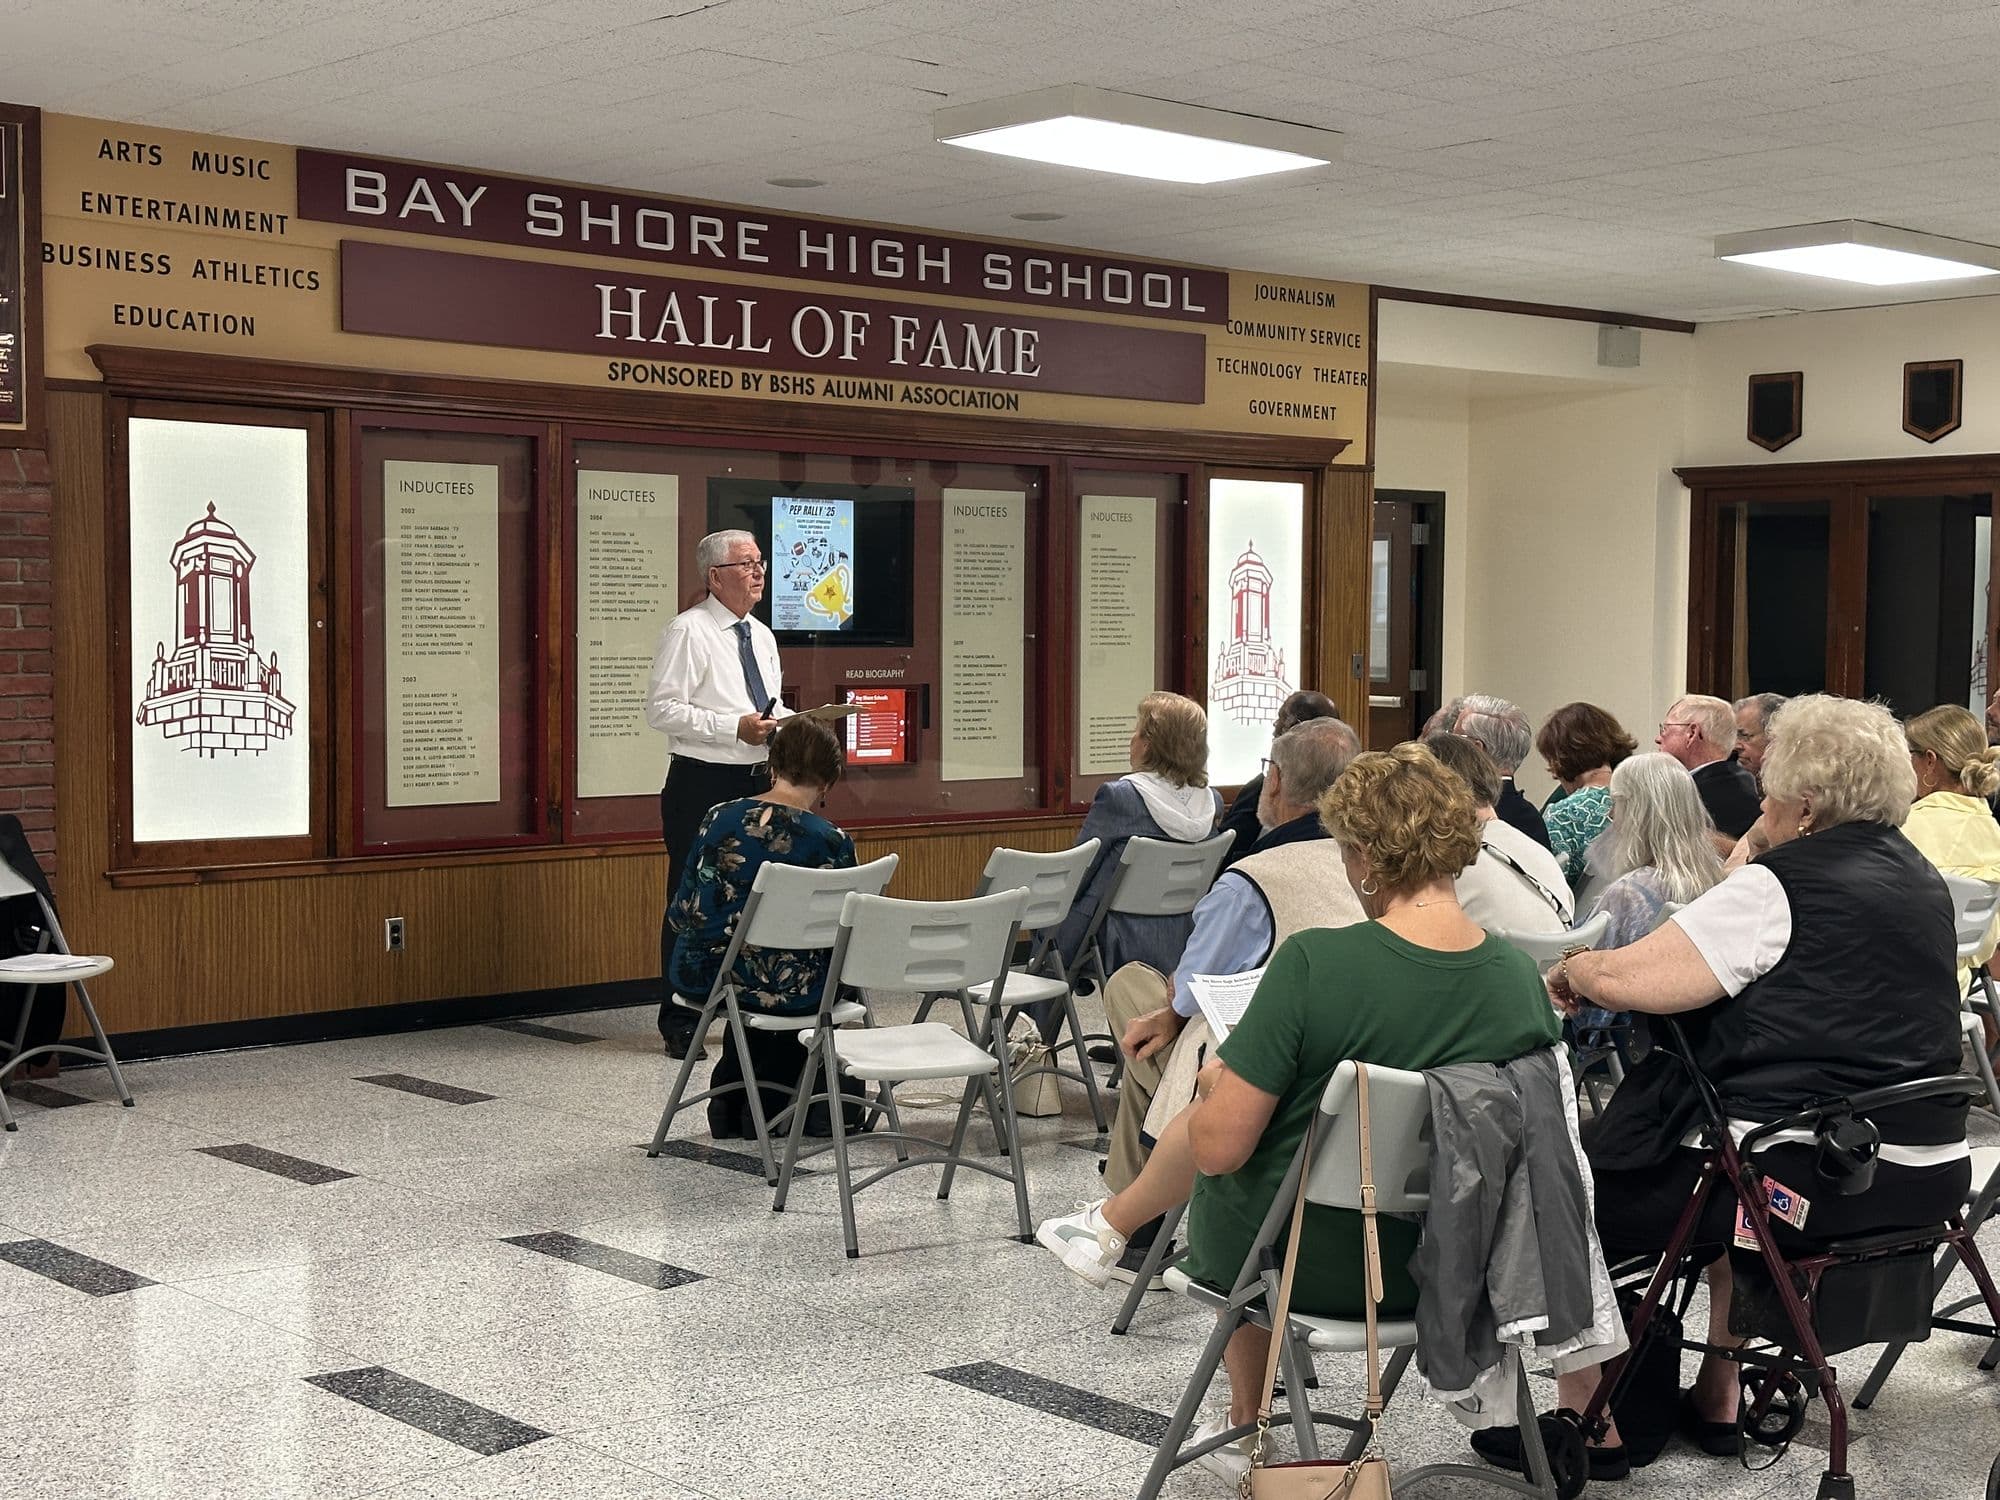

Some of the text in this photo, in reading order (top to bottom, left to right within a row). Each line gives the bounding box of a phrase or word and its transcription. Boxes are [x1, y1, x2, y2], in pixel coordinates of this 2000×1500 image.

[98, 138, 271, 180] ARTS MUSIC
[81, 191, 288, 235] ENTERTAINMENT
[345, 168, 1206, 313] BAY SHORE HIGH SCHOOL
[42, 242, 320, 290] BUSINESS ATHLETICS
[1254, 284, 1336, 308] JOURNALISM
[114, 304, 256, 336] EDUCATION
[594, 283, 1042, 378] HALL OF FAME
[1226, 319, 1361, 349] COMMUNITY SERVICE
[1216, 357, 1368, 386] TECHNOLOGY THEATER
[608, 362, 1019, 412] SPONSORED BY BSHS ALUMNI ASSOCIATION
[1249, 399, 1336, 421] GOVERNMENT
[400, 480, 474, 495] INDUCTEES
[589, 488, 656, 503] INDUCTEES
[789, 504, 836, 516] PEP RALLY '25
[953, 505, 1008, 518] INDUCTEES
[1090, 512, 1133, 522] INDUCTEES
[846, 669, 905, 678] READ BIOGRAPHY
